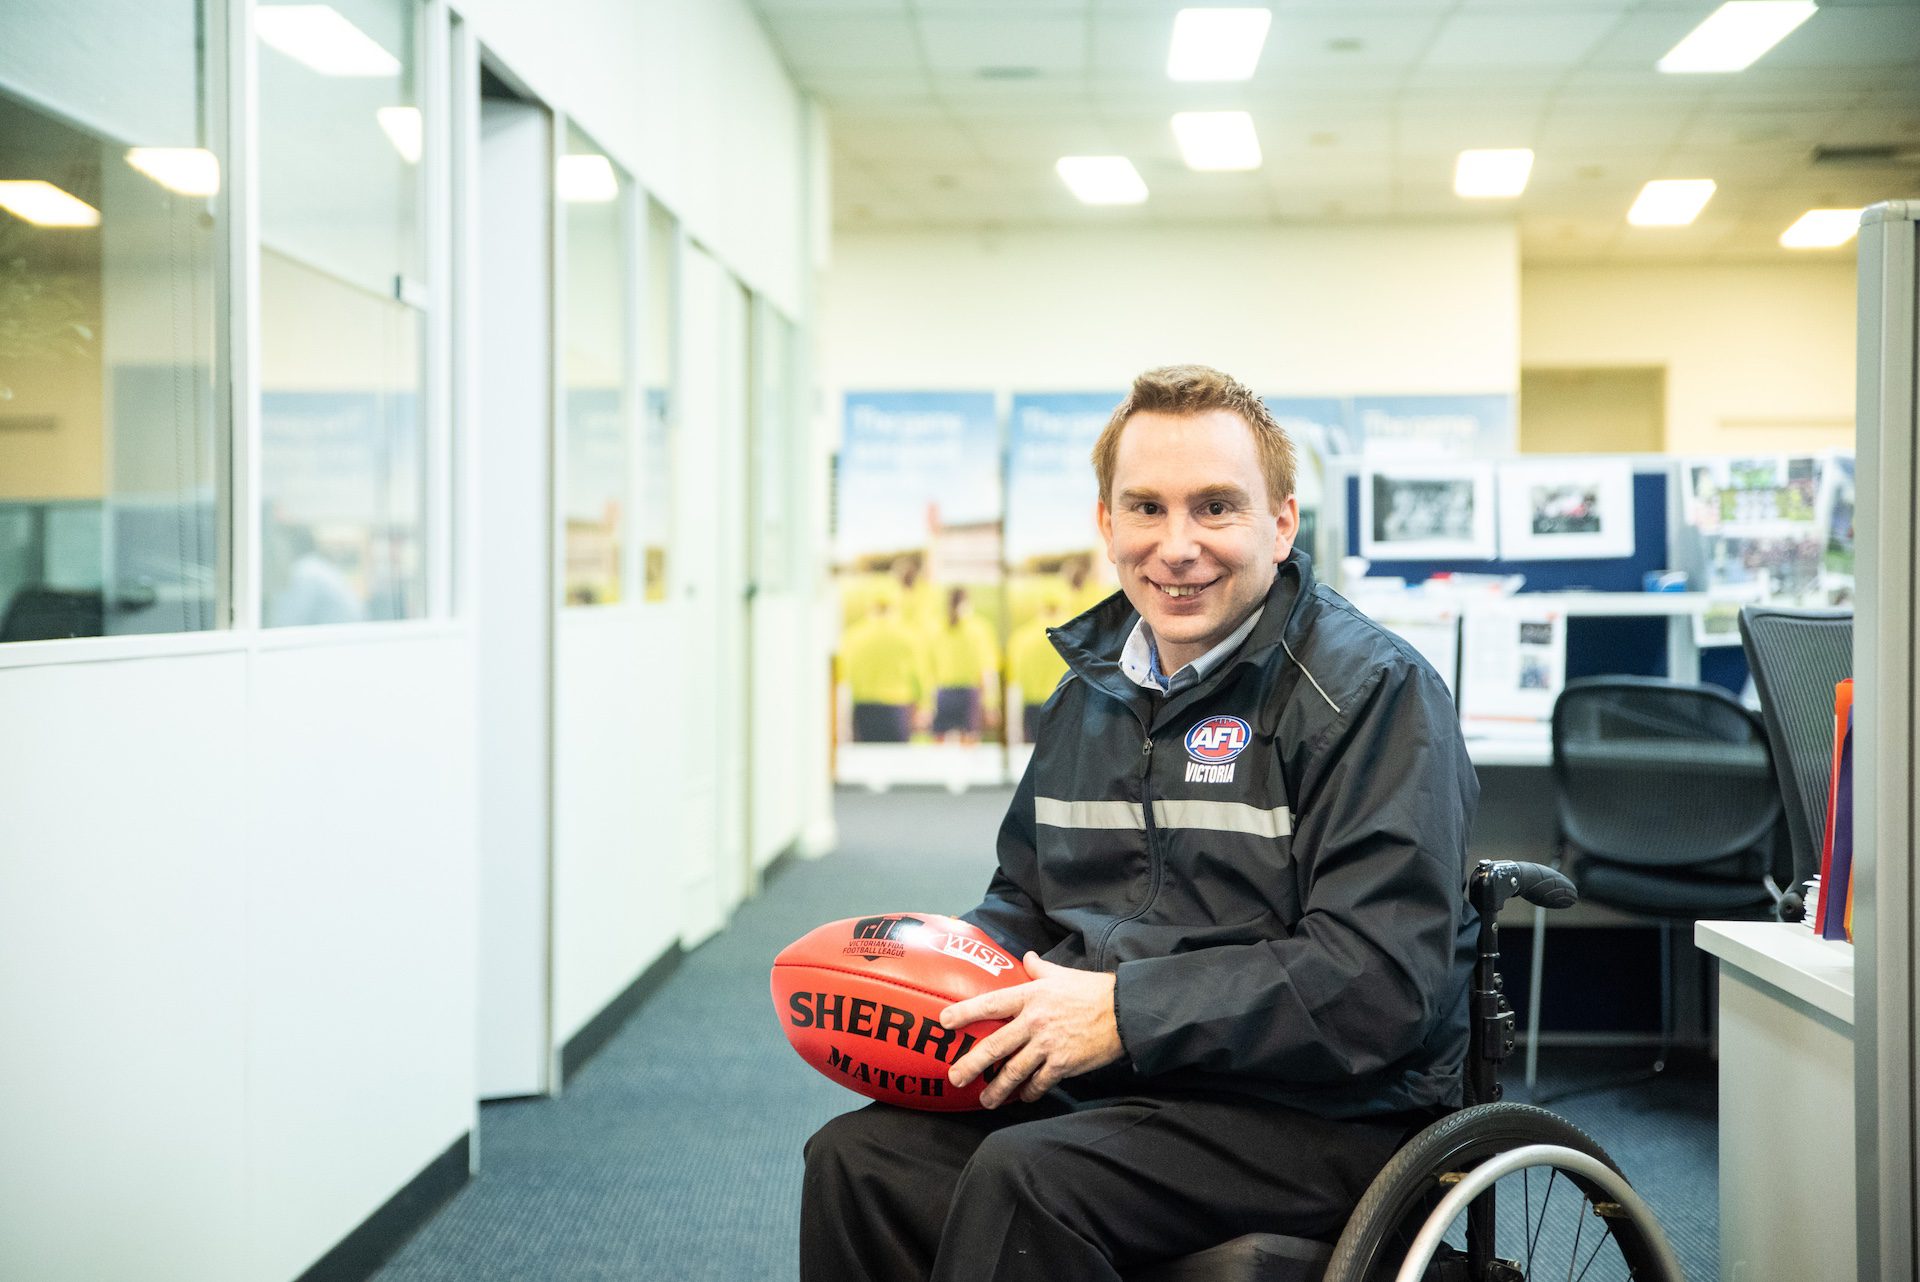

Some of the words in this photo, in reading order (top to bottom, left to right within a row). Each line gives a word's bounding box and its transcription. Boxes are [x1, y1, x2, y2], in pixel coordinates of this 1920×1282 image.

[1189, 727, 1245, 750] AFL
[1184, 761, 1236, 783] VICTORIA
[842, 946, 877, 954] FOOTBALL
[878, 947, 907, 958] LEAGUE
[849, 940, 887, 949] VICTORIAN
[887, 942, 904, 950] FIDA
[943, 932, 1006, 968] WISE
[827, 1045, 945, 1097] MATCH
